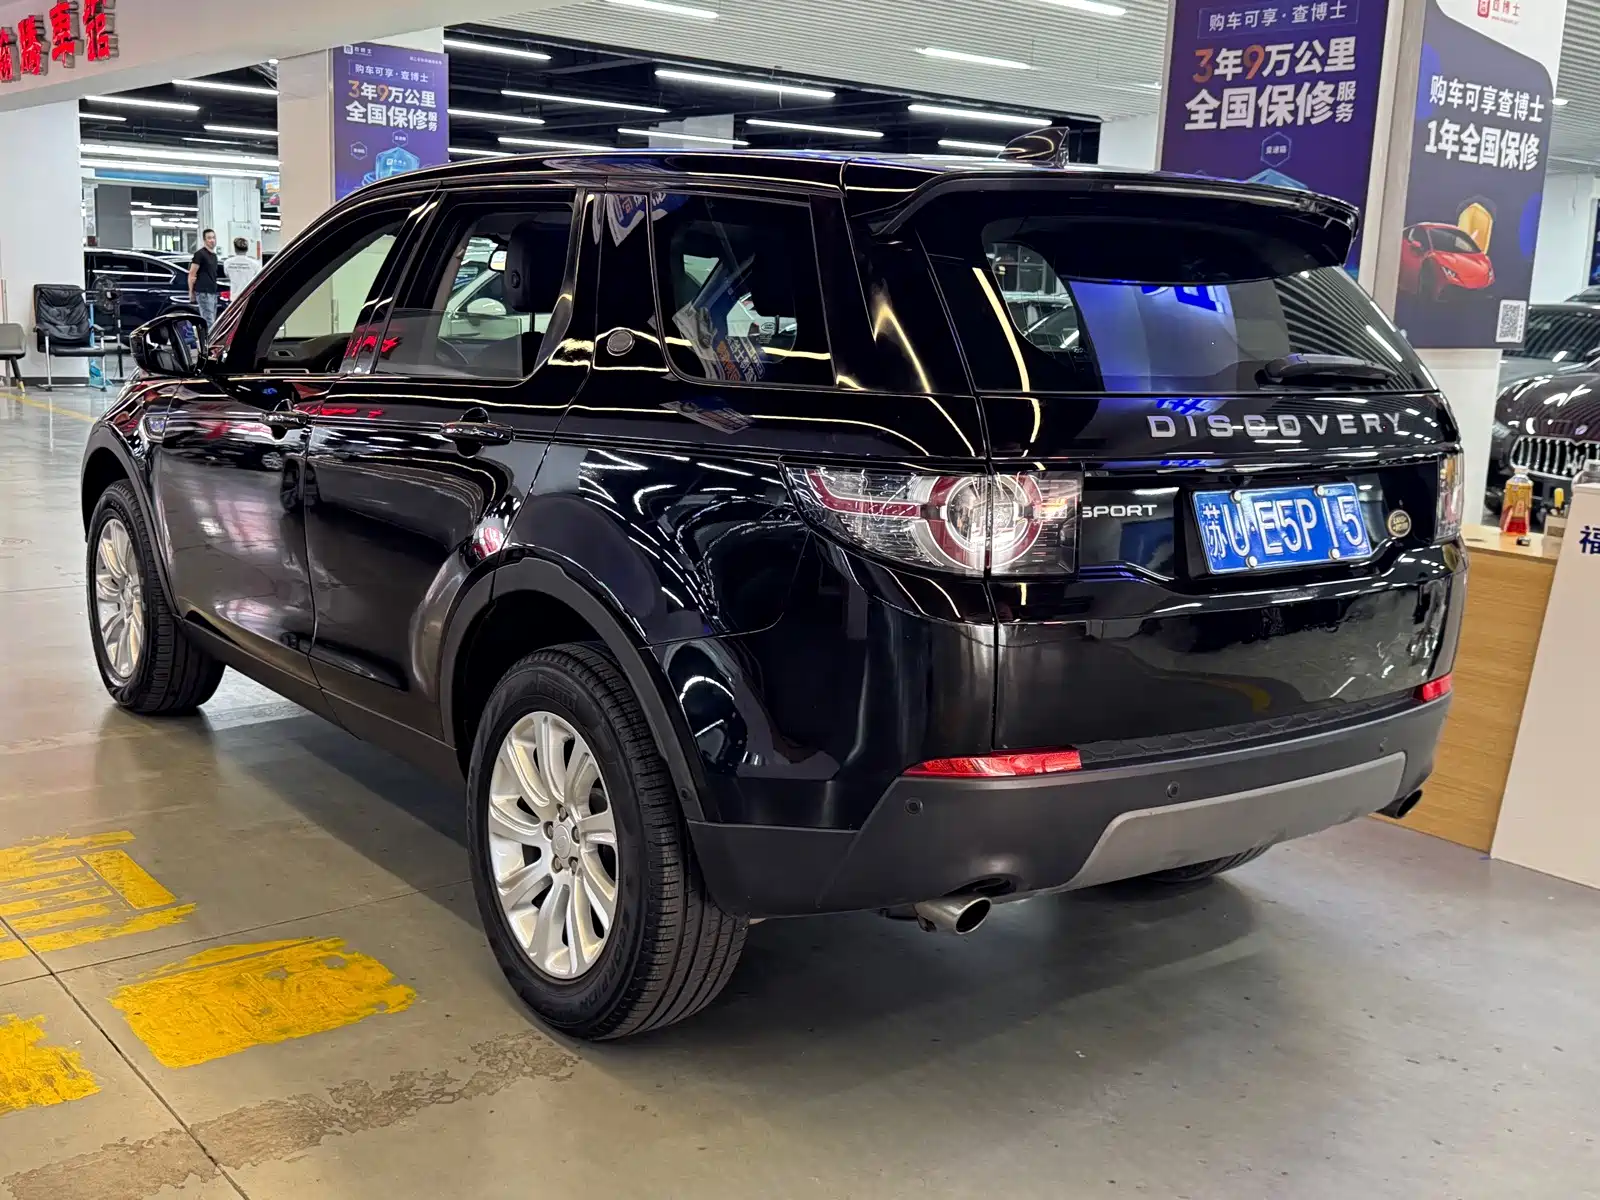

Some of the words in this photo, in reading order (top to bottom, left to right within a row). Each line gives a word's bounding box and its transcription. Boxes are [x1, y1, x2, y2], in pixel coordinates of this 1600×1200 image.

[1192, 36, 1356, 83] 3年9万公里
[348, 79, 437, 108] 3年9万公里
[1429, 75, 1545, 123] 购车可享查博士
[1424, 118, 1540, 171] 1年全国保修
[1147, 412, 1401, 438] DISCOVERY
[1081, 504, 1158, 518] SPORT
